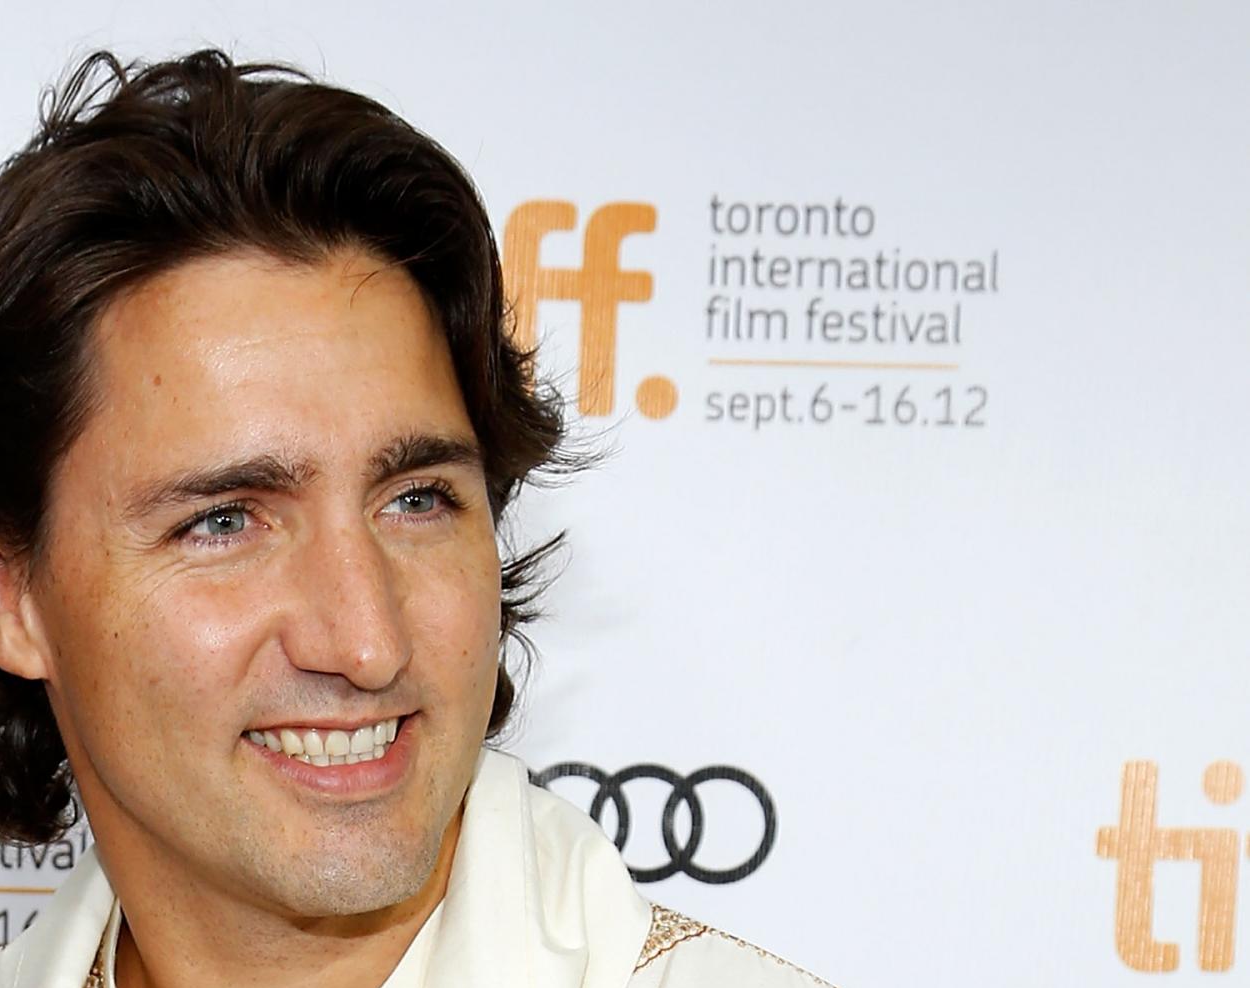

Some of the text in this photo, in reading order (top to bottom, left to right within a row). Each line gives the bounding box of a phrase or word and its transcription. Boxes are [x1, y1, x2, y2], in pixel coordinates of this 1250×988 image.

[709, 194, 876, 238] toronto
[709, 244, 999, 293] international
[706, 294, 962, 345] film festival
[705, 383, 988, 430] sept.6-16.12
[1095, 759, 1250, 974] ti
